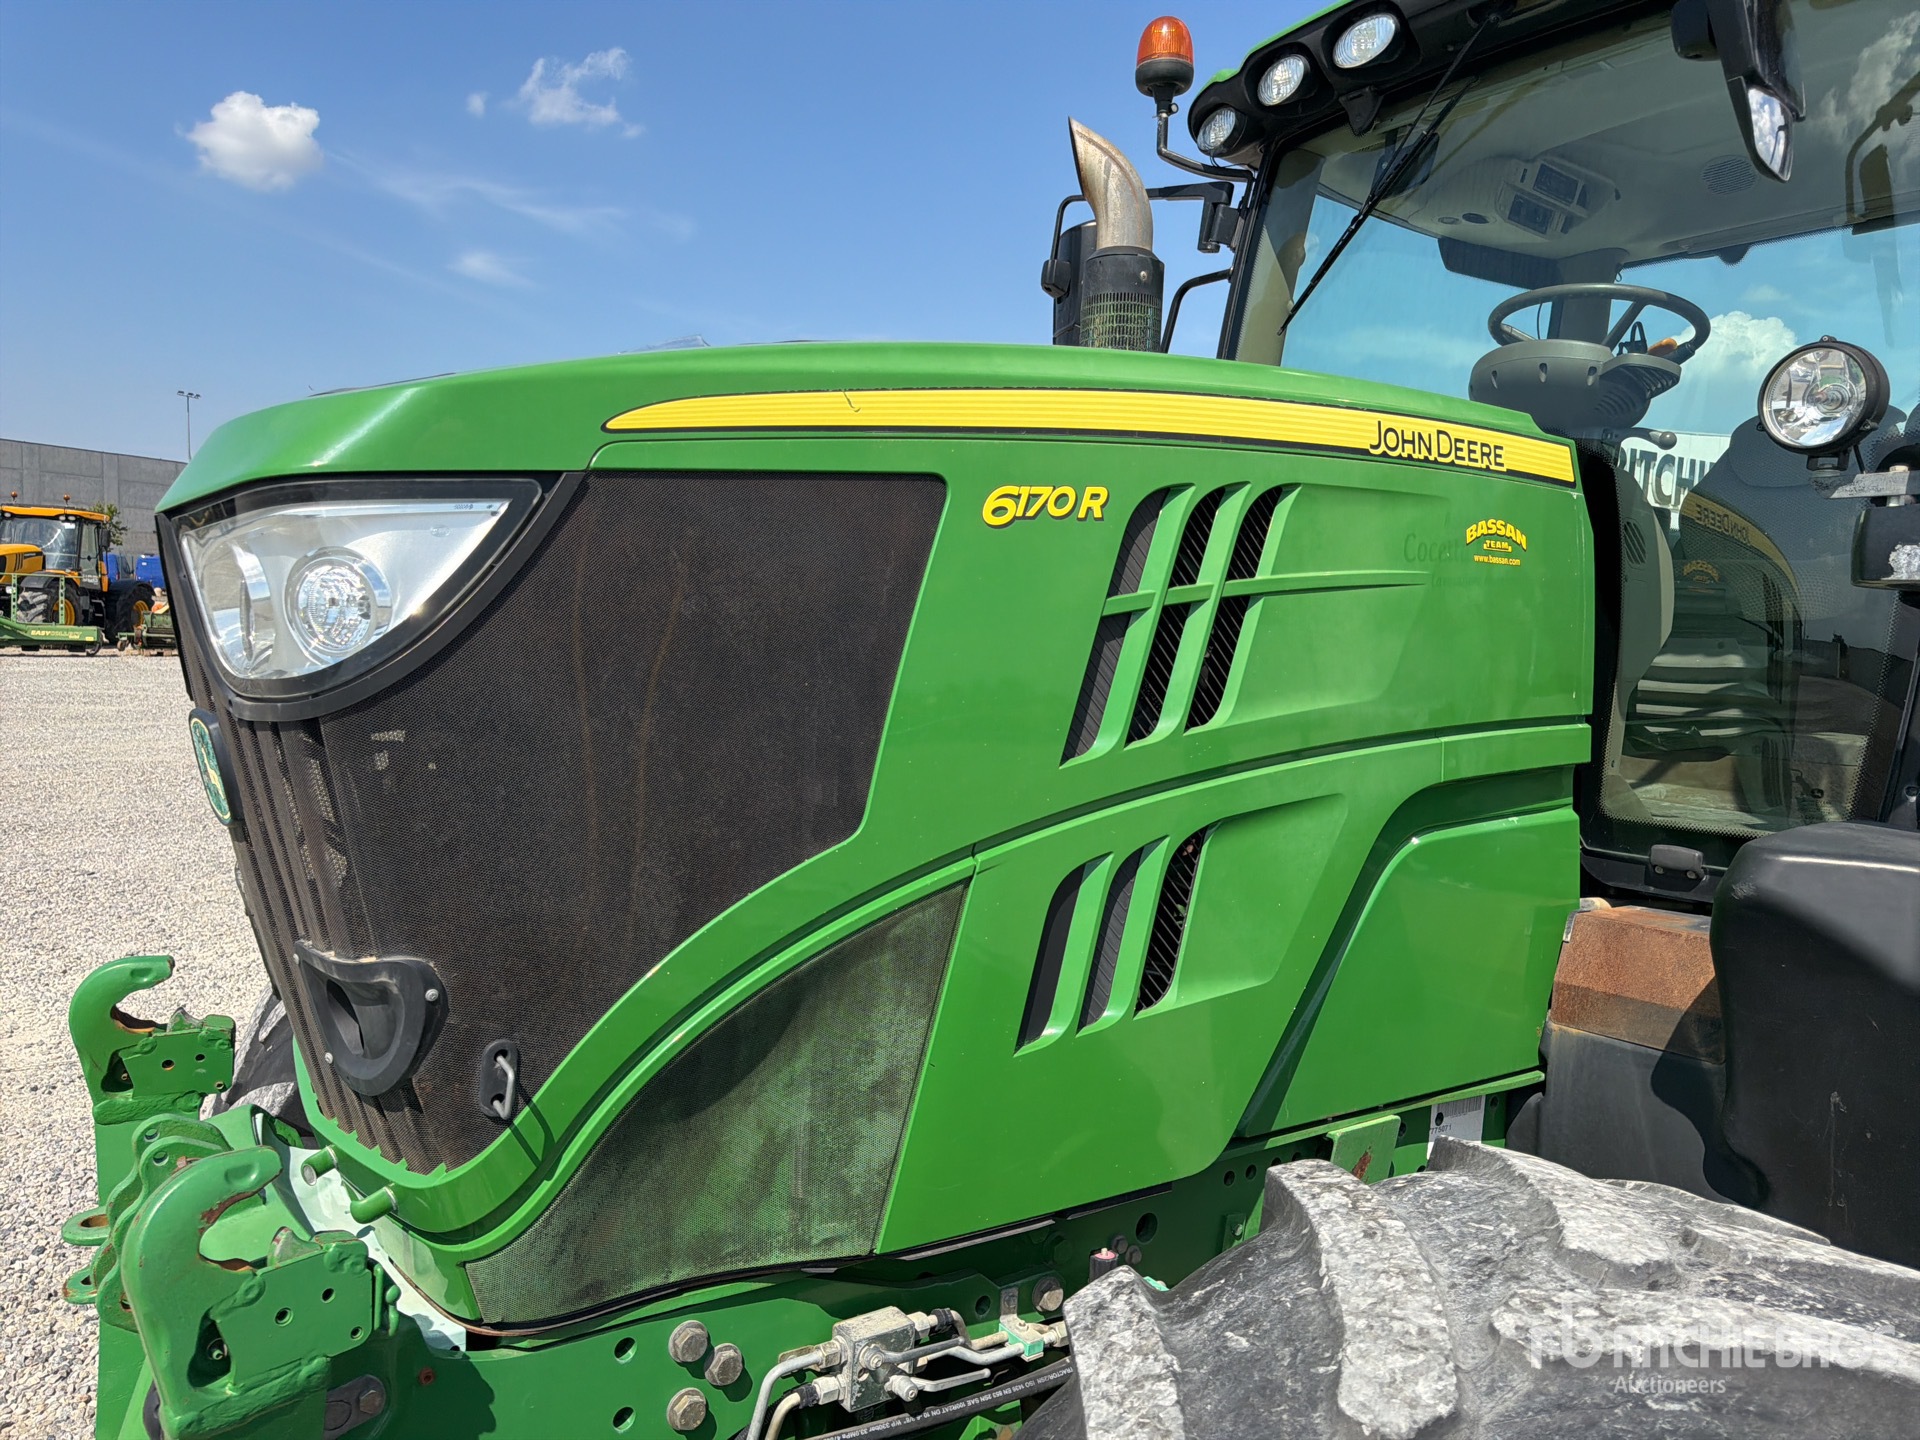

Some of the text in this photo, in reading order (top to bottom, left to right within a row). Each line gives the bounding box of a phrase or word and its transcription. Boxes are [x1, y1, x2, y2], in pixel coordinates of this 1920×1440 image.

[1369, 420, 1505, 469] JOHN DEERE
[1466, 518, 1527, 551] BASSAN
[1485, 539, 1510, 550] TEAM
[1473, 553, 1521, 567] www.bassan.com
[1002, 1387, 1012, 1395] EN
[966, 1397, 979, 1406] SAE
[930, 1409, 941, 1418] DN
